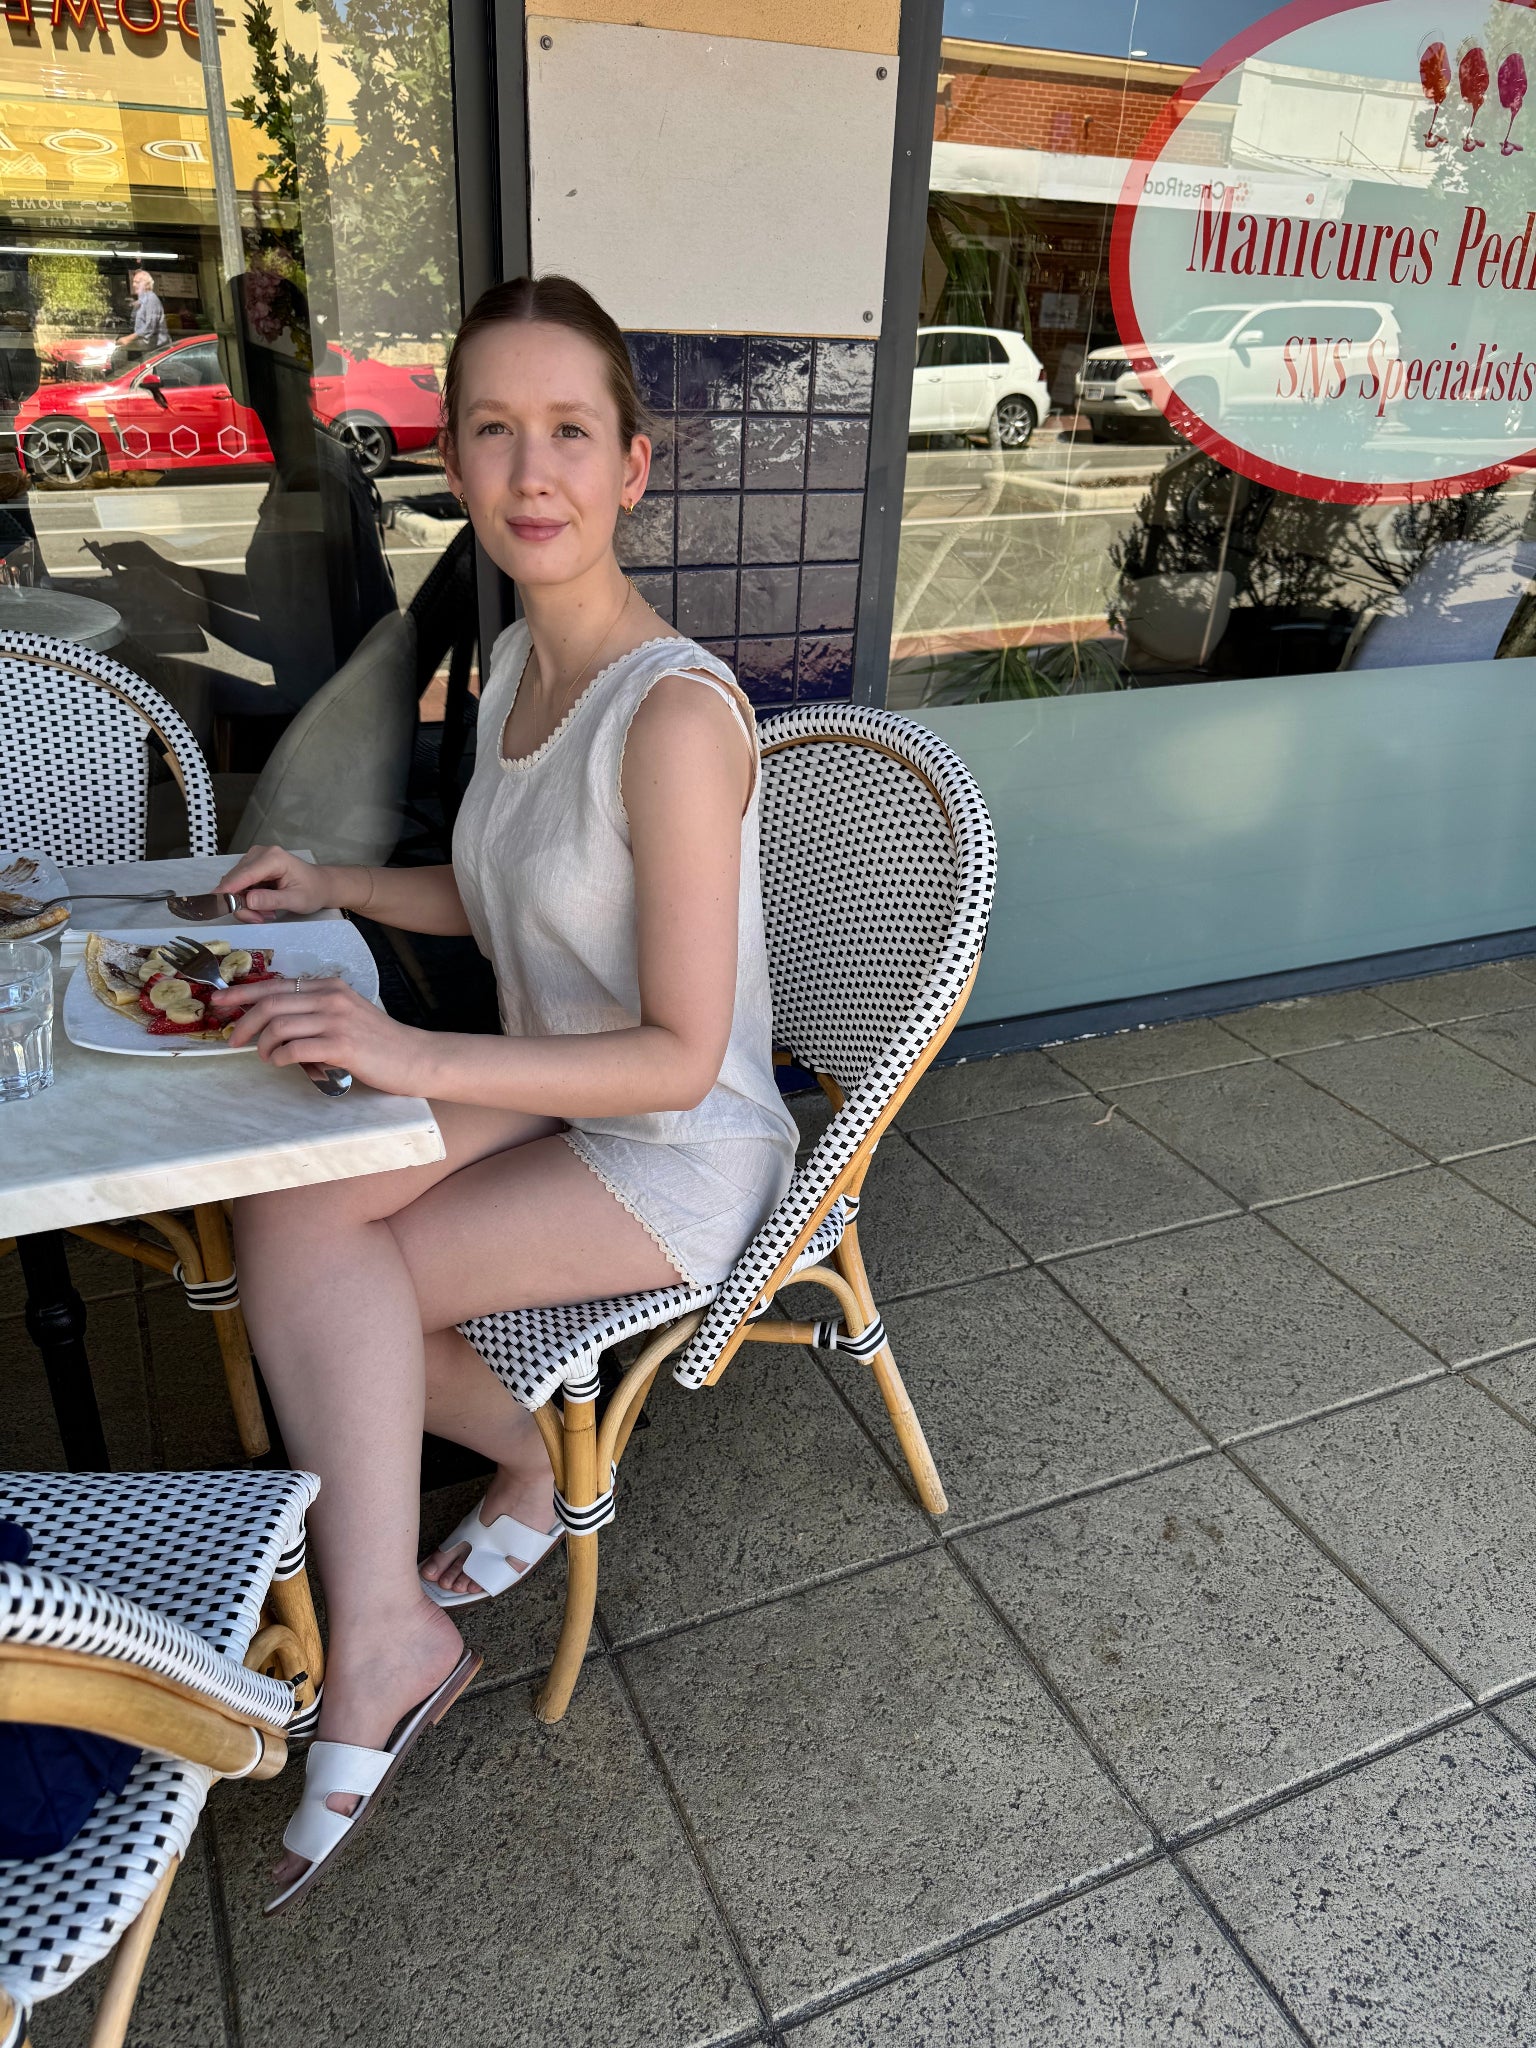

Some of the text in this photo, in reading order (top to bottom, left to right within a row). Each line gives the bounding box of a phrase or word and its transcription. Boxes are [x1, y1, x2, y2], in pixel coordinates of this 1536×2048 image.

[1185, 183, 1440, 286] Manicures
[1275, 335, 1536, 418] SNS Specialists
